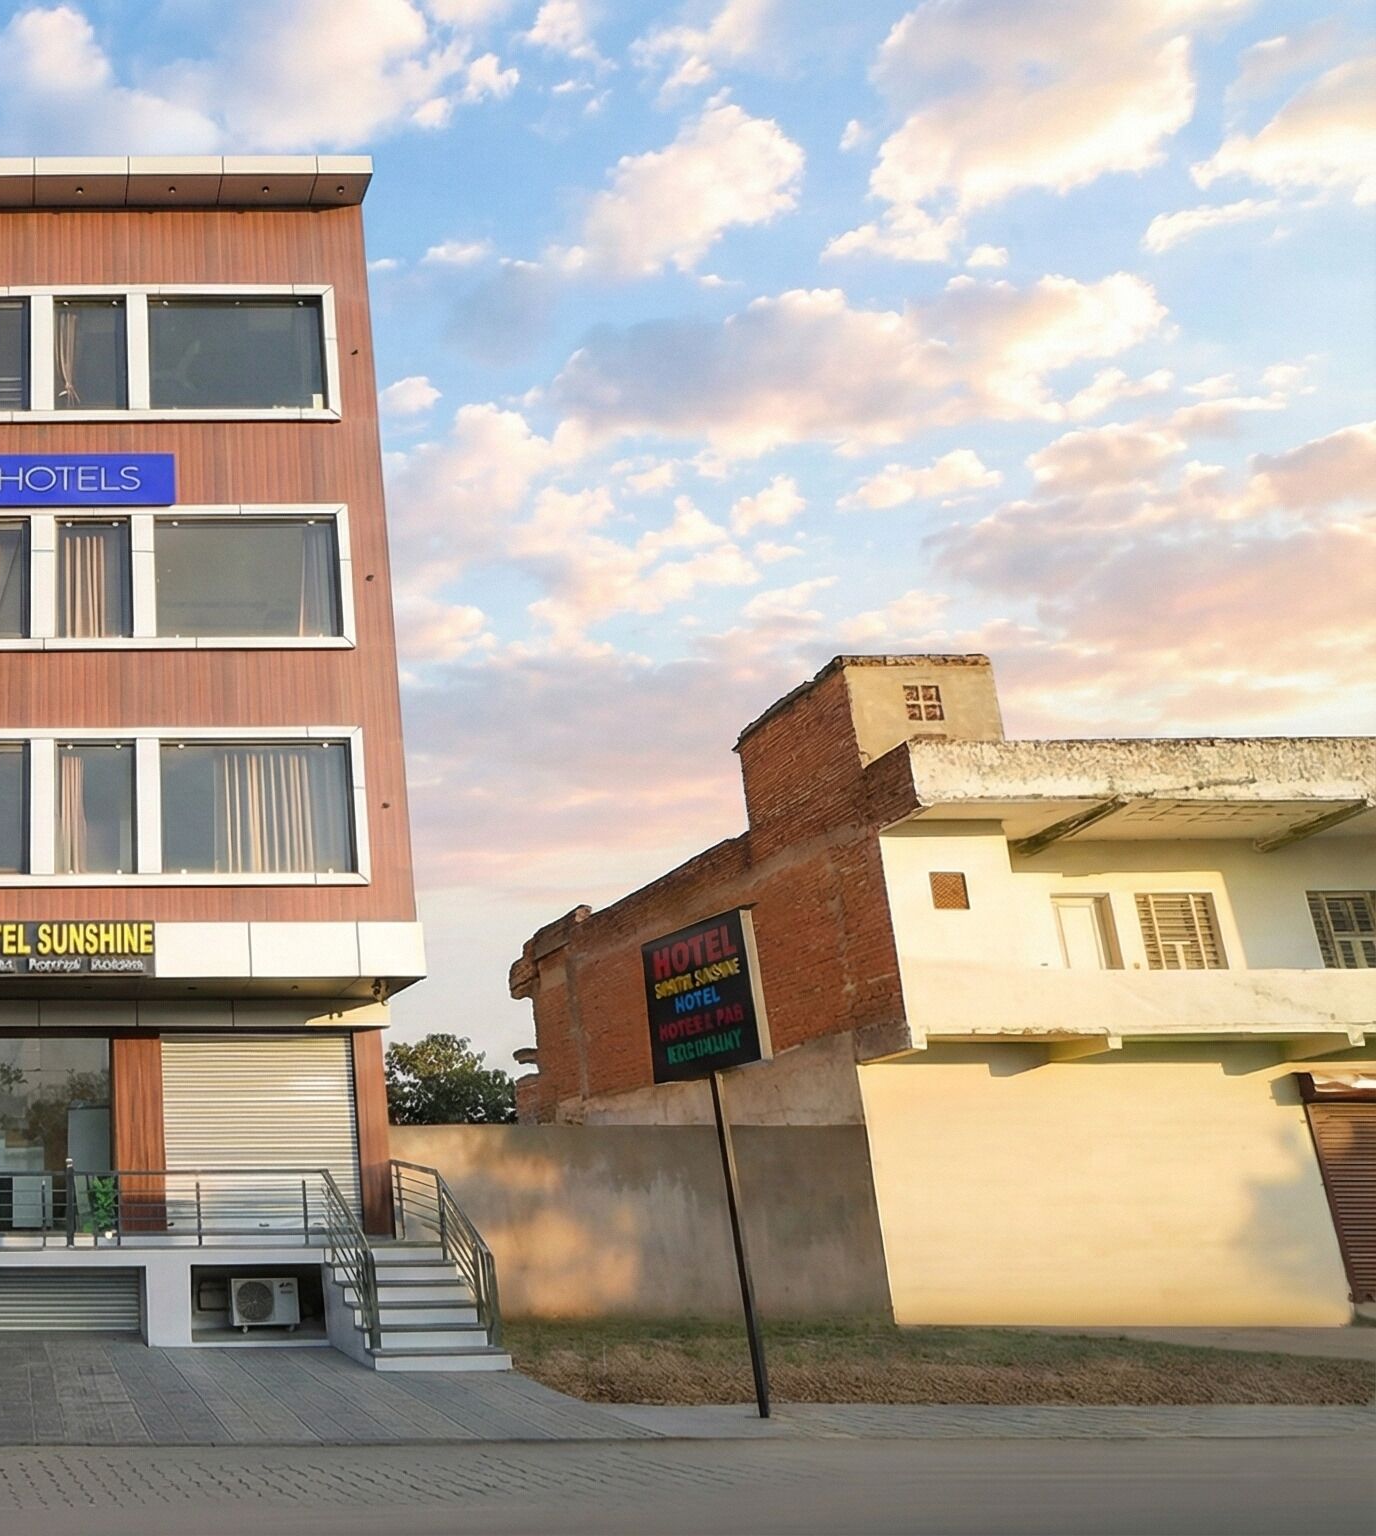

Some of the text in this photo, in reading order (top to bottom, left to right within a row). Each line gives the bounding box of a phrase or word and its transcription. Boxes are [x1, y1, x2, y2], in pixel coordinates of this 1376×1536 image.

[37, 923, 154, 954] SUNSHINE
[653, 925, 736, 979] HOTEL
[676, 986, 721, 1013] HOTEL
